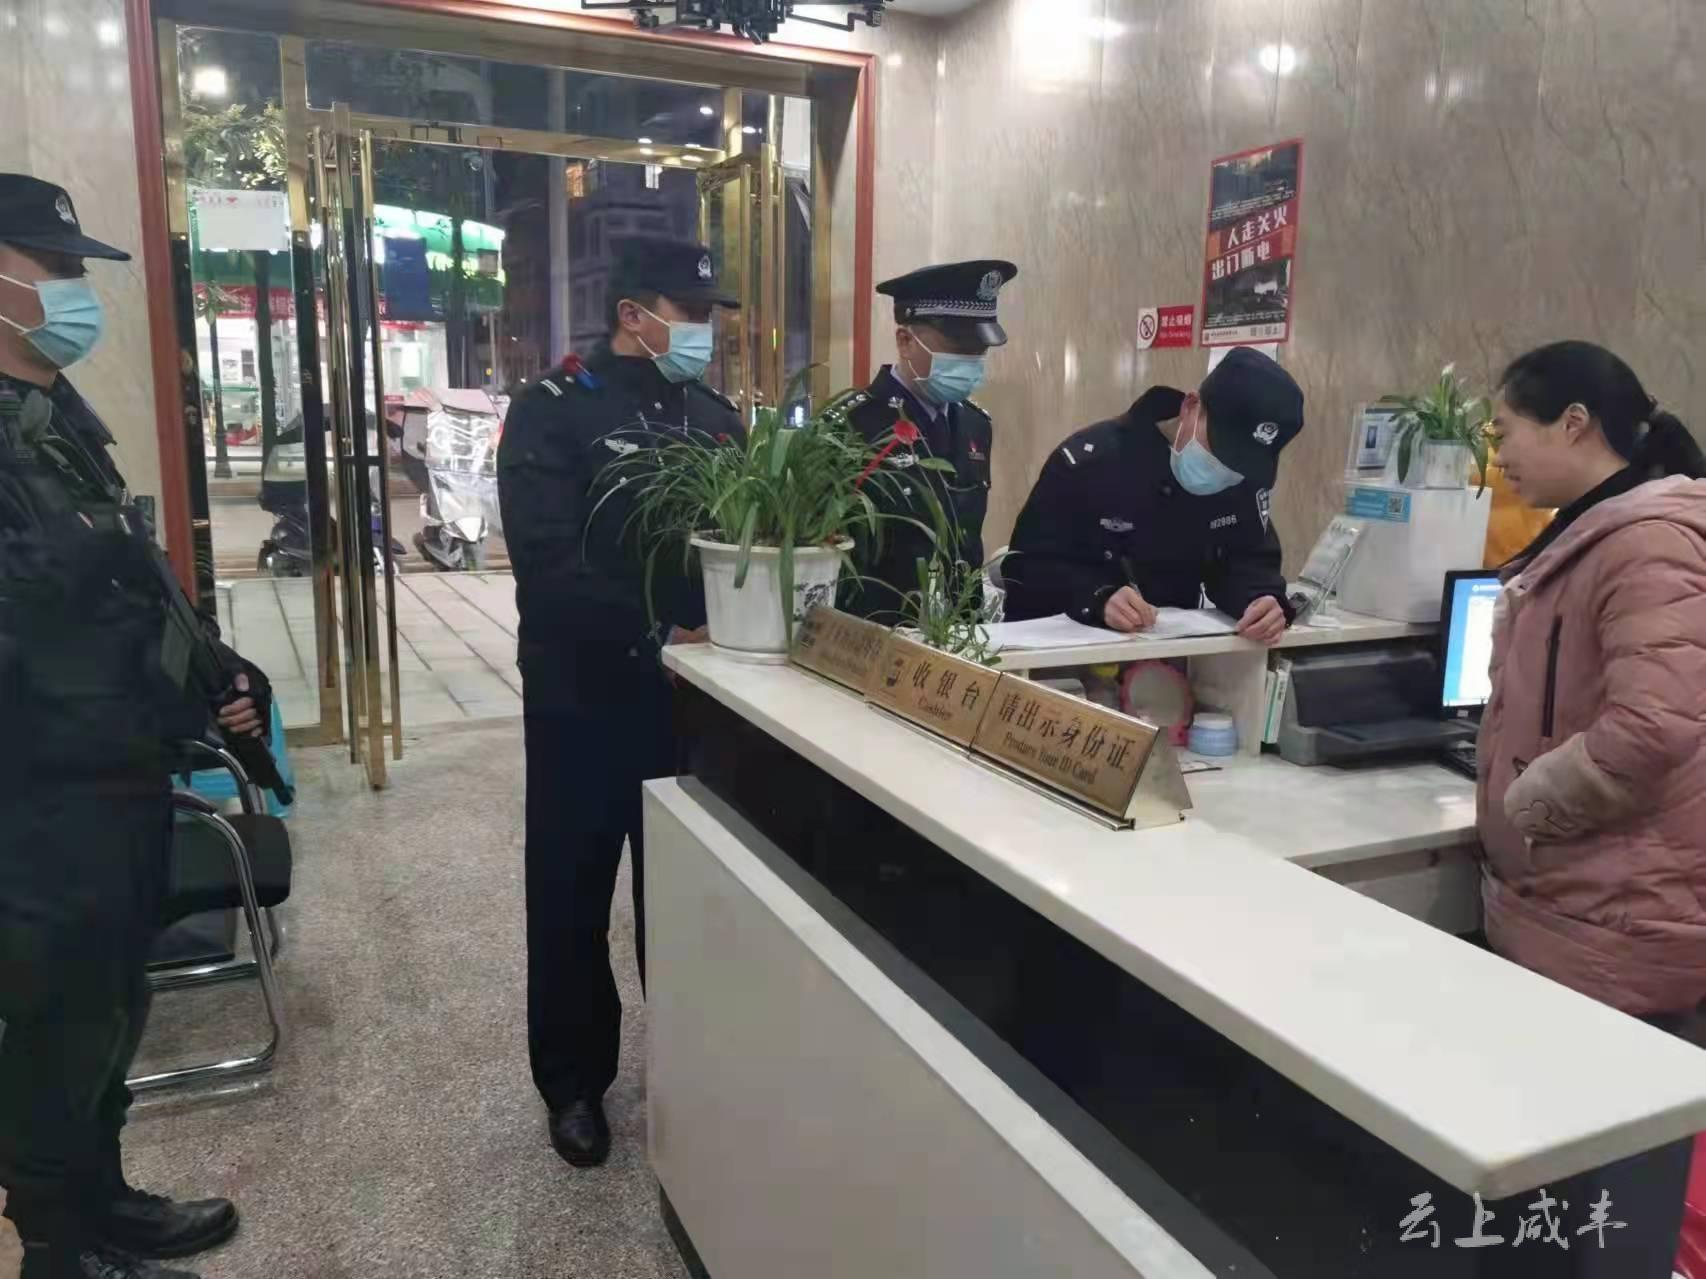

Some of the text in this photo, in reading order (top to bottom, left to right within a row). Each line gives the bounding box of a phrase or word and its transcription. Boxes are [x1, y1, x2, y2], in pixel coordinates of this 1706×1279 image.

[1227, 205, 1288, 249] 人走关火
[1211, 240, 1272, 281] 出门断电
[911, 660, 981, 711] 收银台
[998, 691, 1137, 770] 请出示身份证
